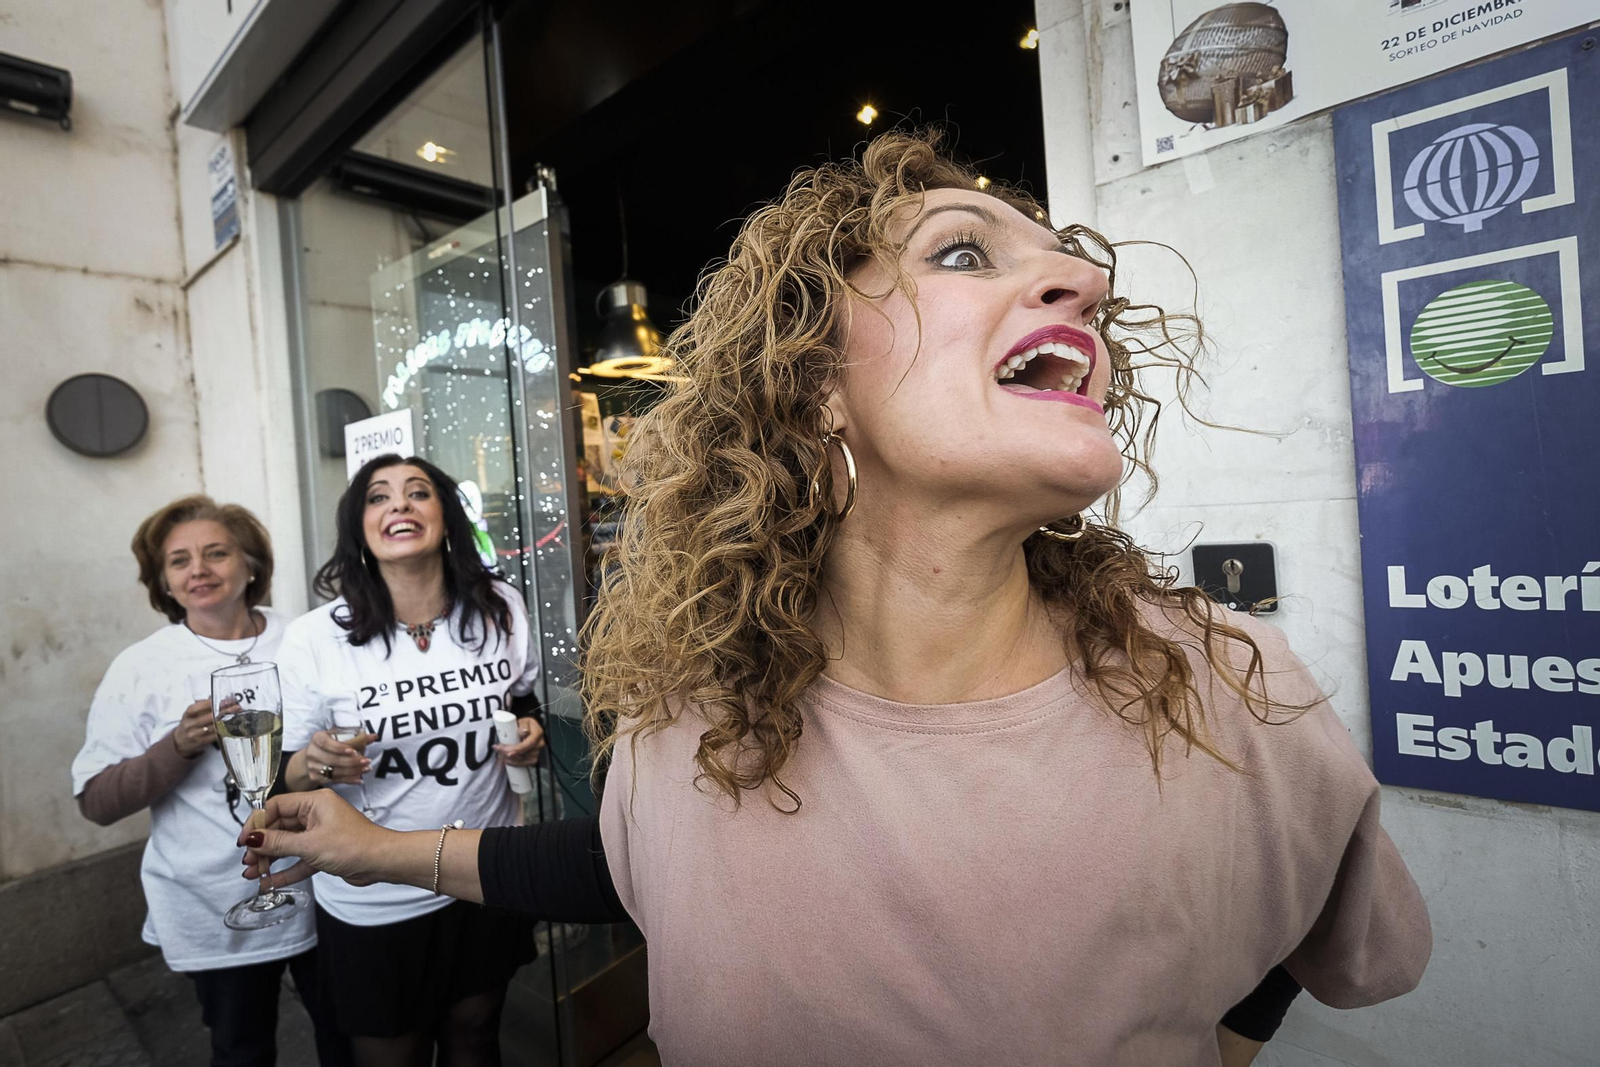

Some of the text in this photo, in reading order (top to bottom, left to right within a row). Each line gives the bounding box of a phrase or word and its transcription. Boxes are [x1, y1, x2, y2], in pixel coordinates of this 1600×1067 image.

[1381, 0, 1523, 51] 22 DE DICIEMBR
[1389, 8, 1524, 62] SORTEO DE NAVIDAD
[361, 427, 403, 452] PREMIO
[395, 659, 511, 702] PREMIO
[1390, 639, 1600, 698] Apues
[374, 725, 497, 786] AQU
[1396, 712, 1600, 775] Estad
